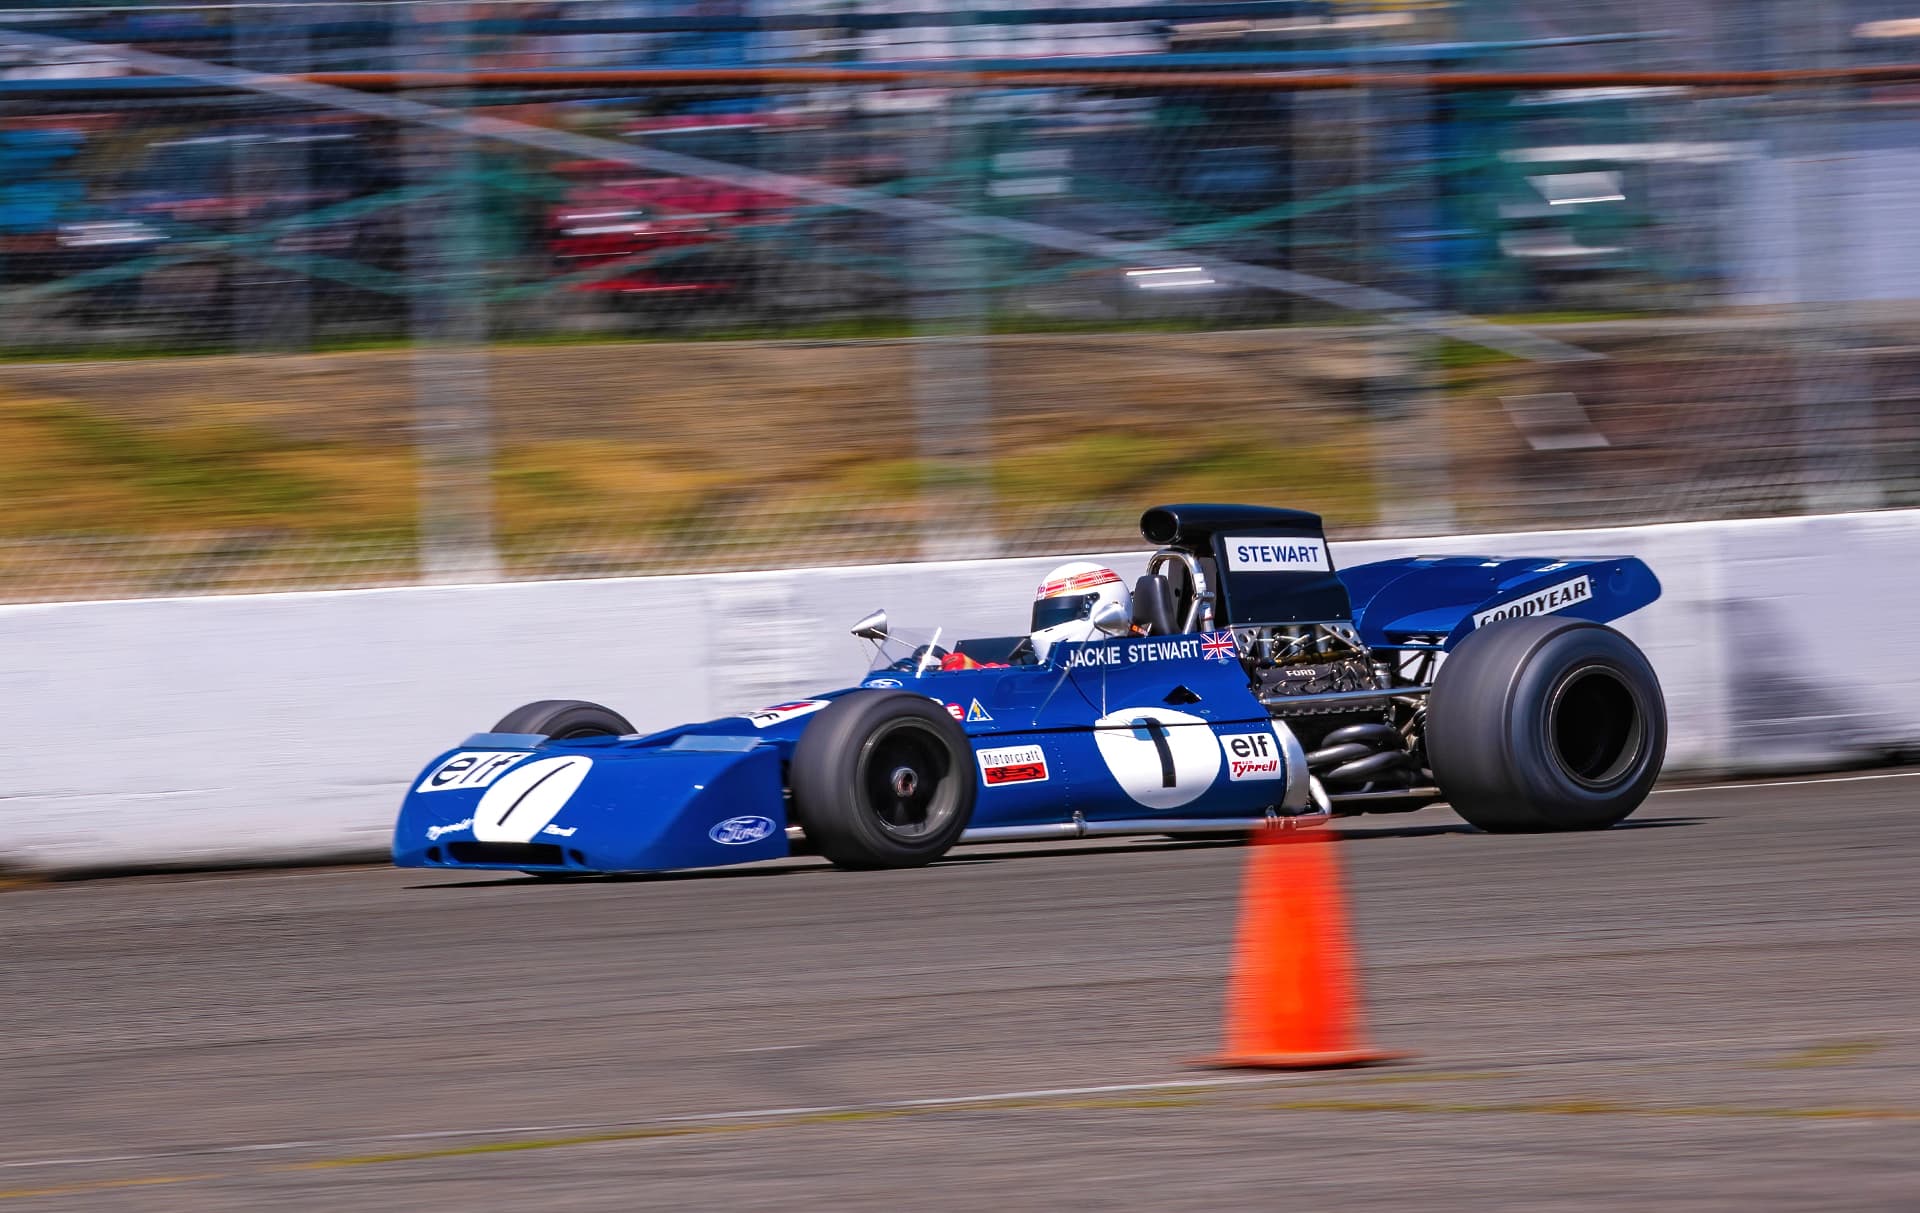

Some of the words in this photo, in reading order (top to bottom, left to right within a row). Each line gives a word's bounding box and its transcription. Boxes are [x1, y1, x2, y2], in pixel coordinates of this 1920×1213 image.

[1237, 545, 1319, 563] STEWART
[1066, 646, 1121, 669] JACKIE
[1128, 640, 1199, 663] STEWART
[1285, 669, 1316, 677] FORD
[983, 750, 1041, 766] Motorcraft
[1143, 717, 1177, 788] 1
[1230, 735, 1268, 758] elf
[431, 754, 523, 786] elf
[1231, 760, 1278, 777] Tyrrell
[497, 761, 576, 826] 1
